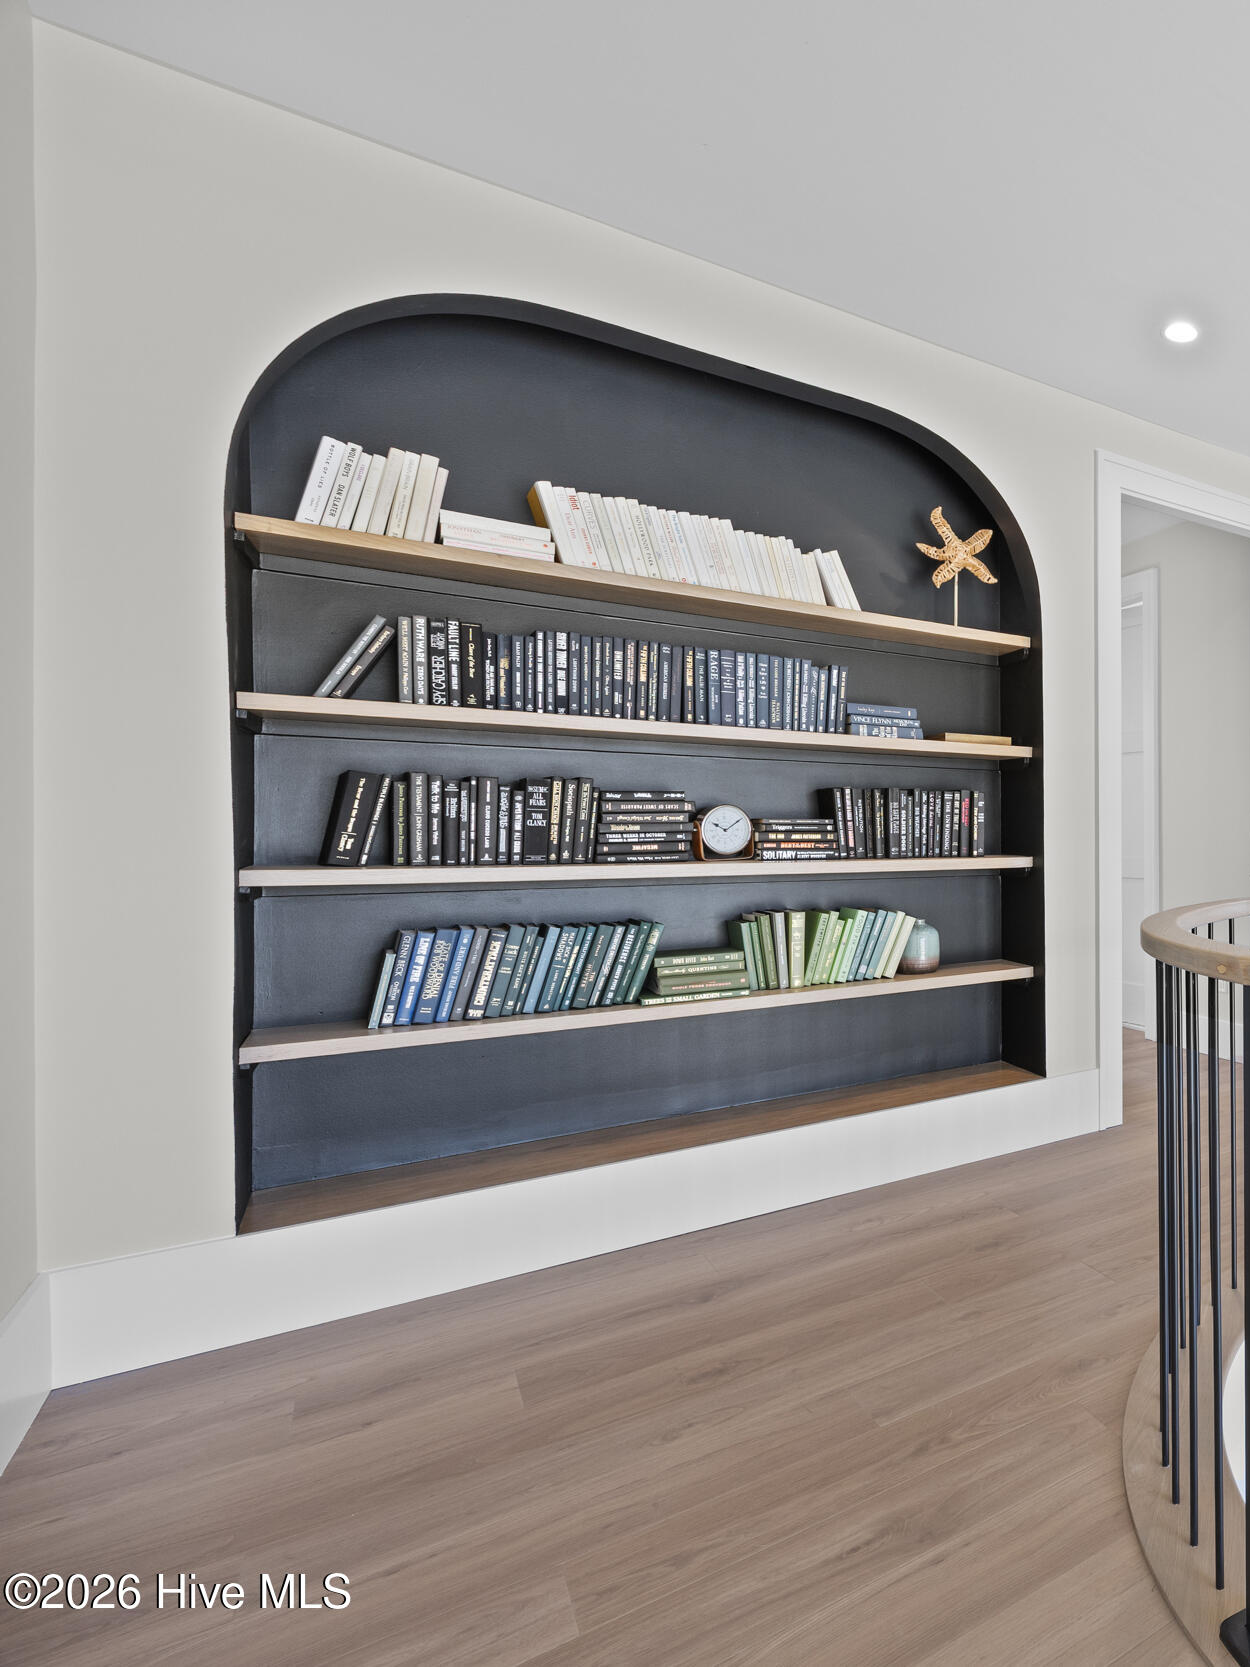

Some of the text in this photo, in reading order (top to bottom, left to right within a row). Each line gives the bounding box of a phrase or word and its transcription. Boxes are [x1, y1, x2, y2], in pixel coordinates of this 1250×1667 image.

[342, 447, 357, 478] WOLF BOYS
[329, 484, 345, 517] DAN SLATER
[415, 618, 425, 662] RUTH WARE
[447, 620, 460, 662] FAULT LINE
[432, 655, 446, 705] SPY CATCHER
[710, 651, 718, 680] RAGE
[872, 716, 892, 725] FLYNN
[431, 780, 440, 795] Talk
[565, 783, 576, 816] Sociopath
[431, 803, 440, 814] Me
[763, 851, 796, 860] SOLITARY
[394, 935, 411, 977] GLENN BECK
[409, 938, 430, 983] LINE OF FIRE
[440, 942, 451, 962] STATE
[555, 933, 569, 961] SHADOWS
[619, 934, 634, 963] RESIDENCE
[430, 973, 444, 998] DENIAL
